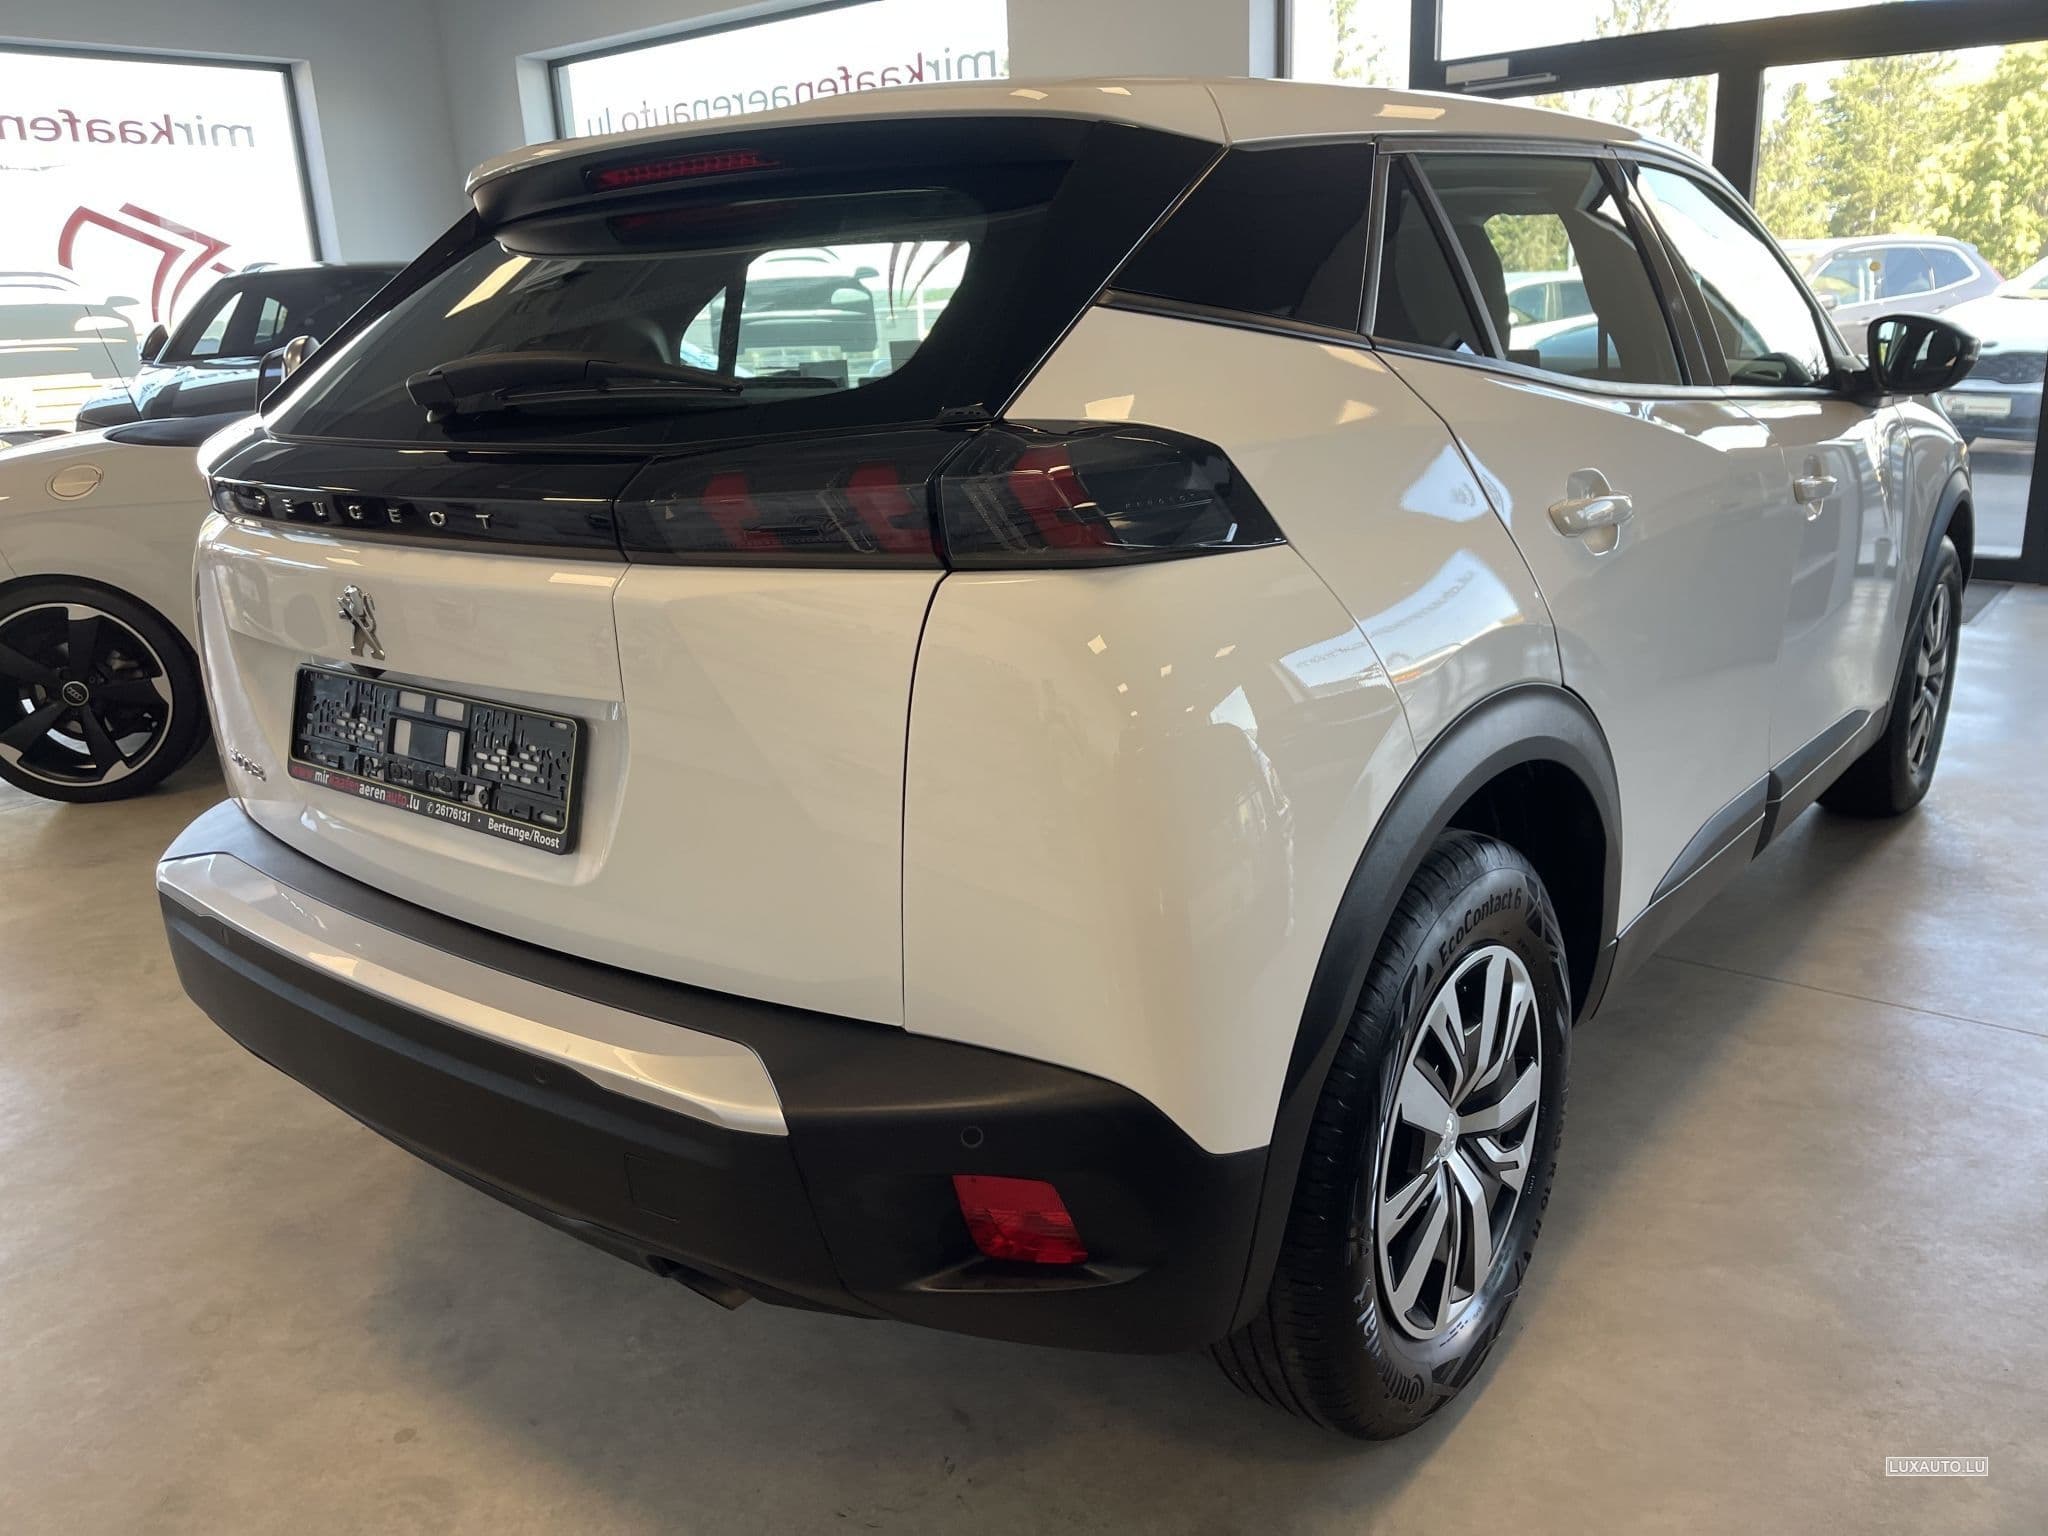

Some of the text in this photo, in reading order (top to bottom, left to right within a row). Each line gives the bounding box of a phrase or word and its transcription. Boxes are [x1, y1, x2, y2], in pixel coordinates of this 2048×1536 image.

[254, 494, 492, 529] PEUGEOT
[435, 803, 471, 824] 26176131
[488, 818, 560, 849] Bertrange/Roost
[1438, 887, 1522, 965] EcoContact 6
